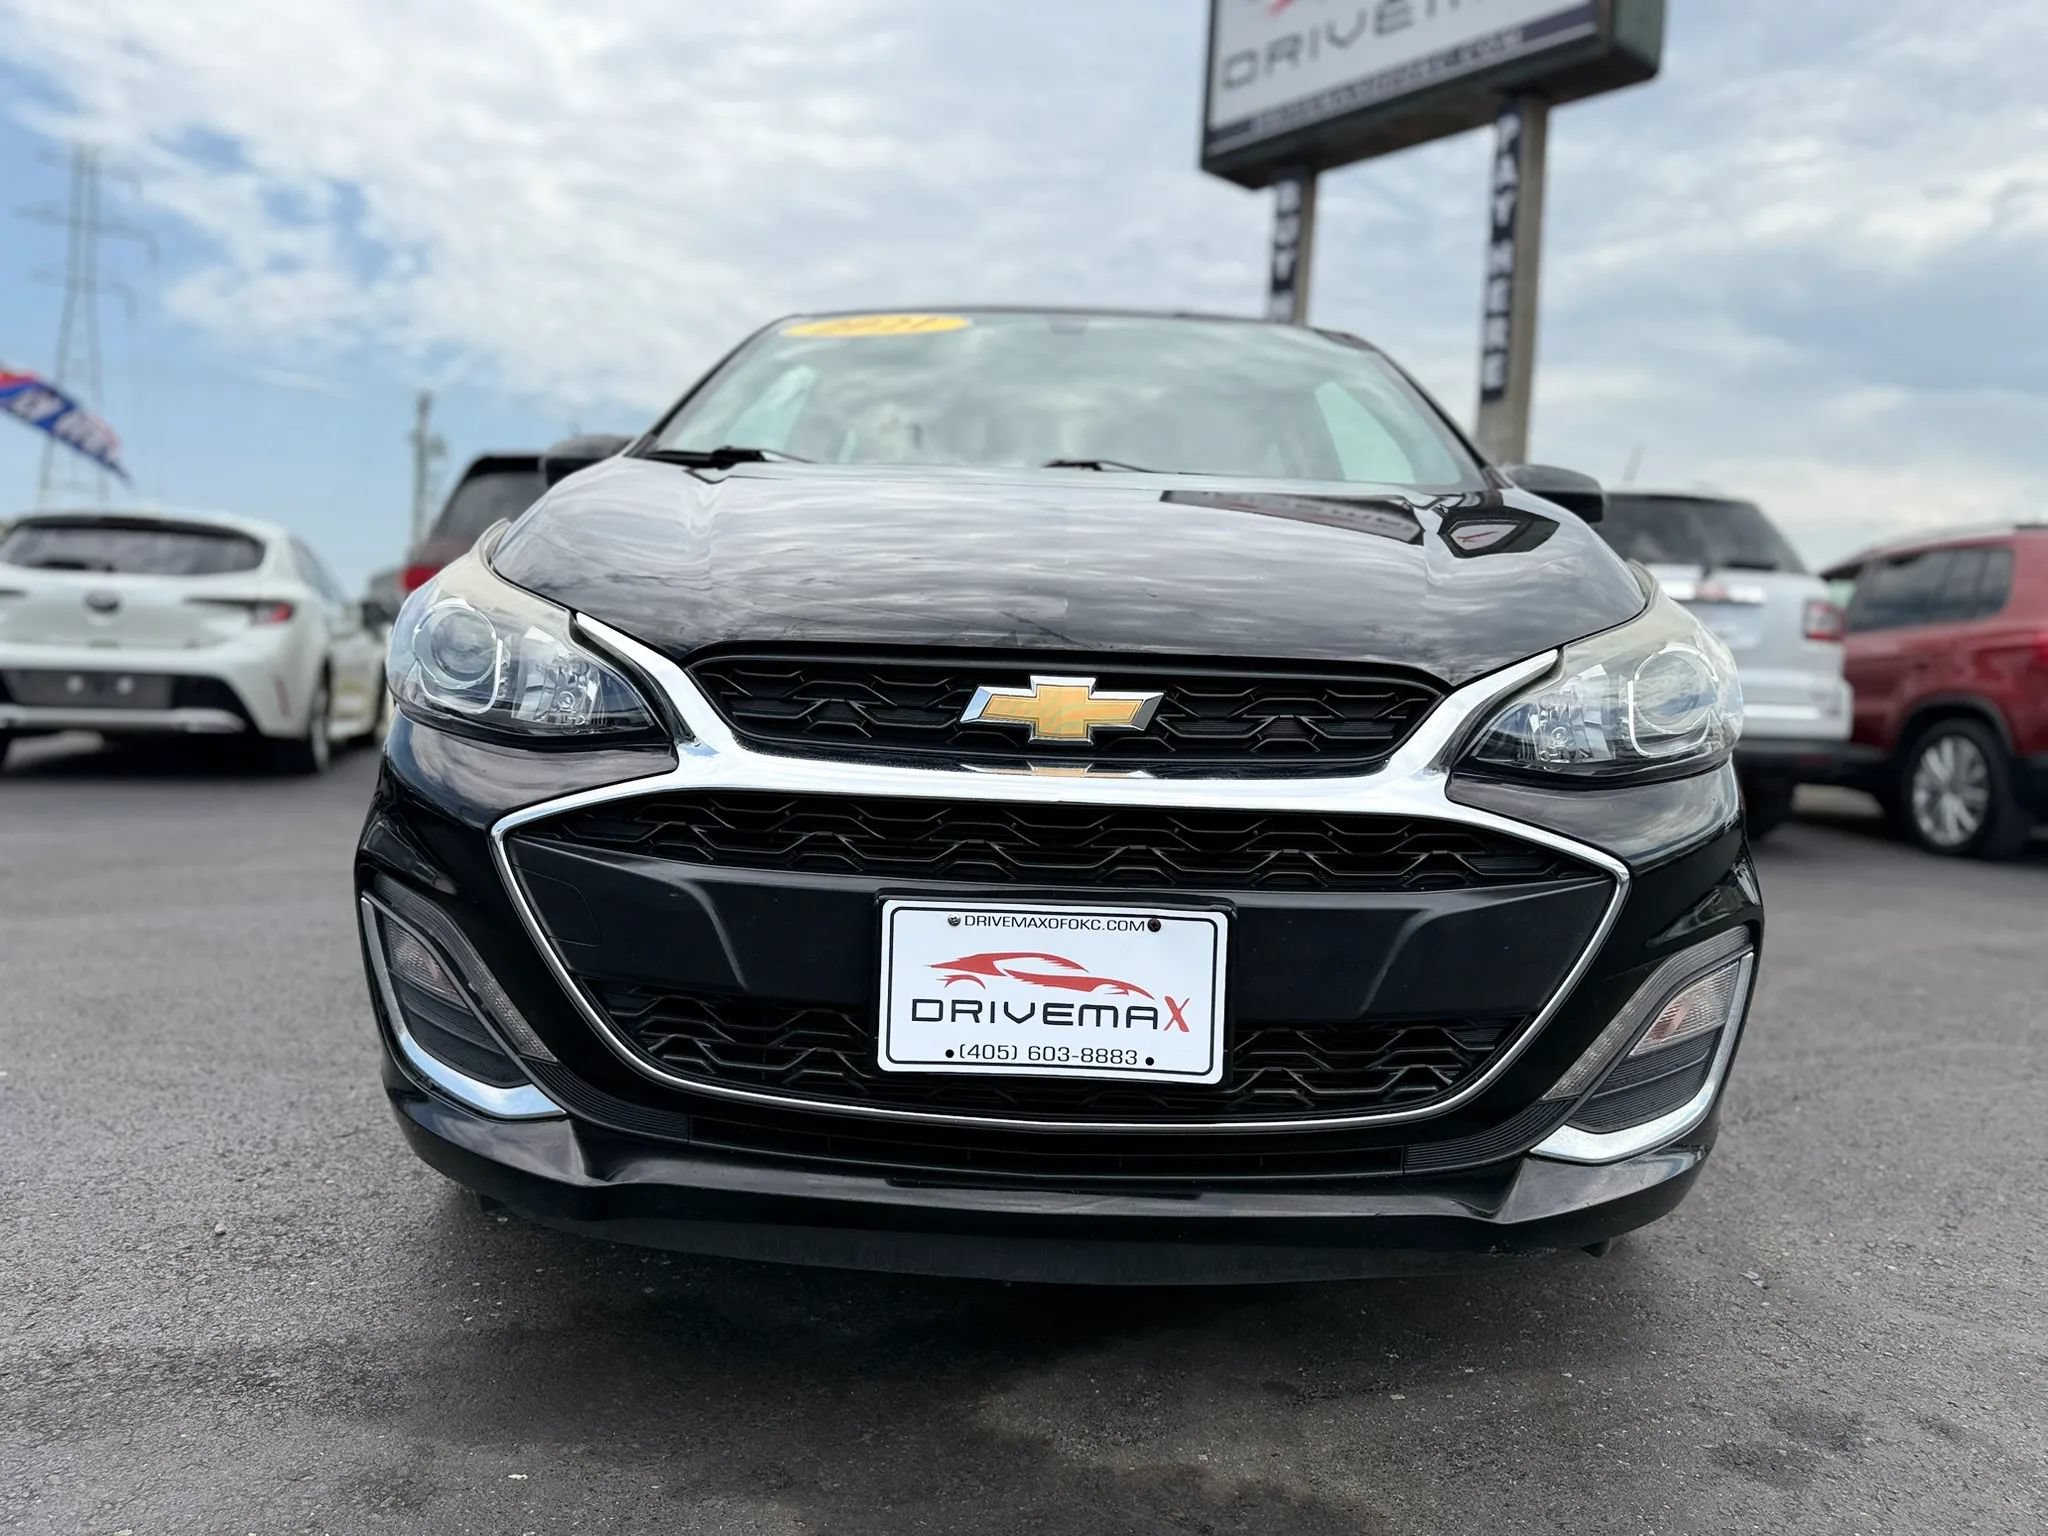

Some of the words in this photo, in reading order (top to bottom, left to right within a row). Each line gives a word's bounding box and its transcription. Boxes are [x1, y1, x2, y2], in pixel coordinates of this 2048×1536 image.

[964, 914, 1146, 933] DRIVEMAXOFOKC.COM
[911, 995, 1191, 1033] DRIVEMAX
[959, 1043, 1018, 1061] (405)
[1028, 1045, 1138, 1066] 603-8883
